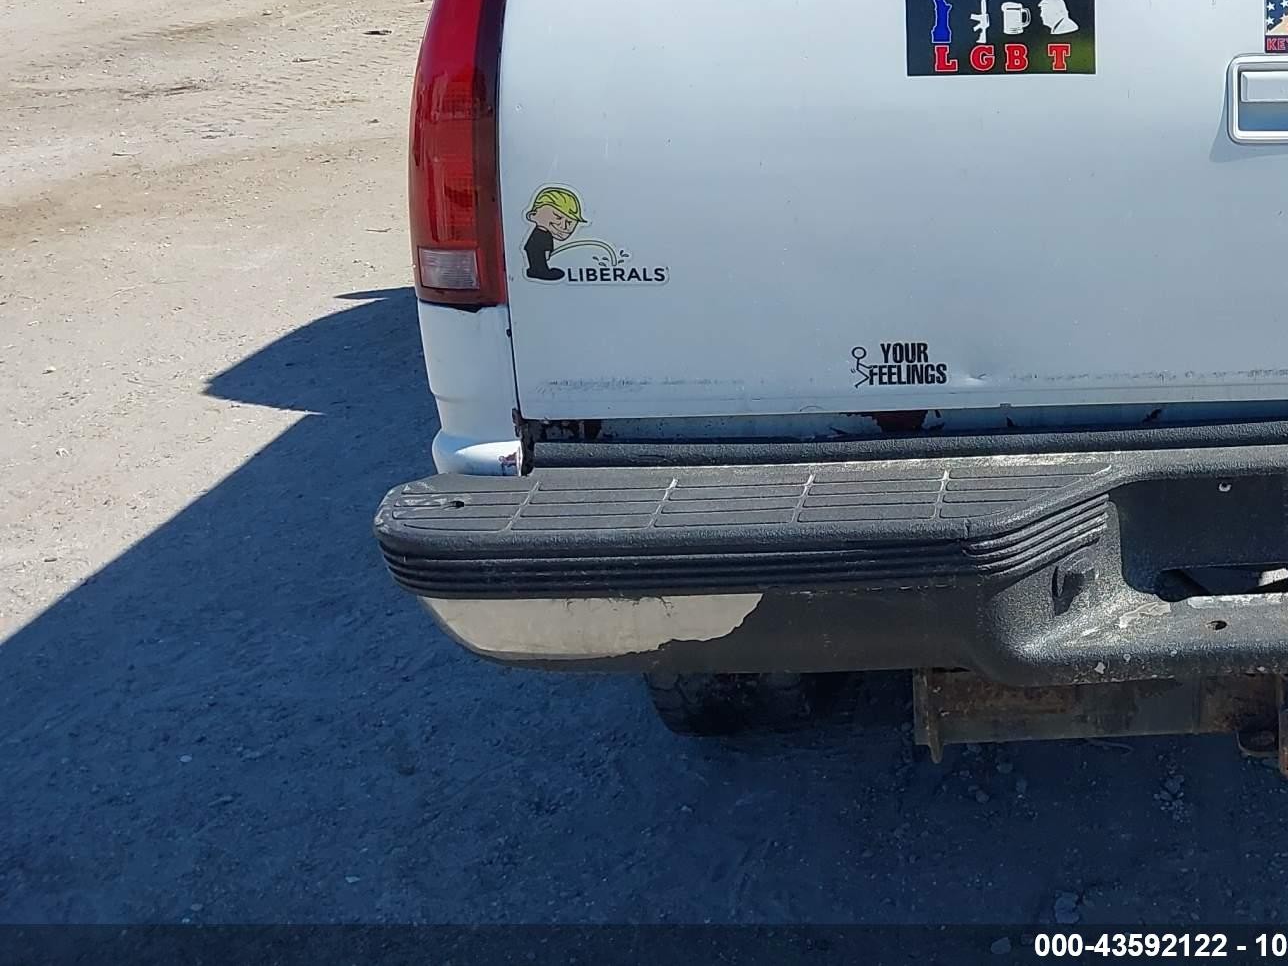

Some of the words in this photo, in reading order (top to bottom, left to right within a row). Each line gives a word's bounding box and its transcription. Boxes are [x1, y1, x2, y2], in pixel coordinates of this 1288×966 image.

[567, 267, 666, 282] LIBERALS
[880, 342, 928, 363] YOUR
[869, 363, 947, 385] FEELINGS
